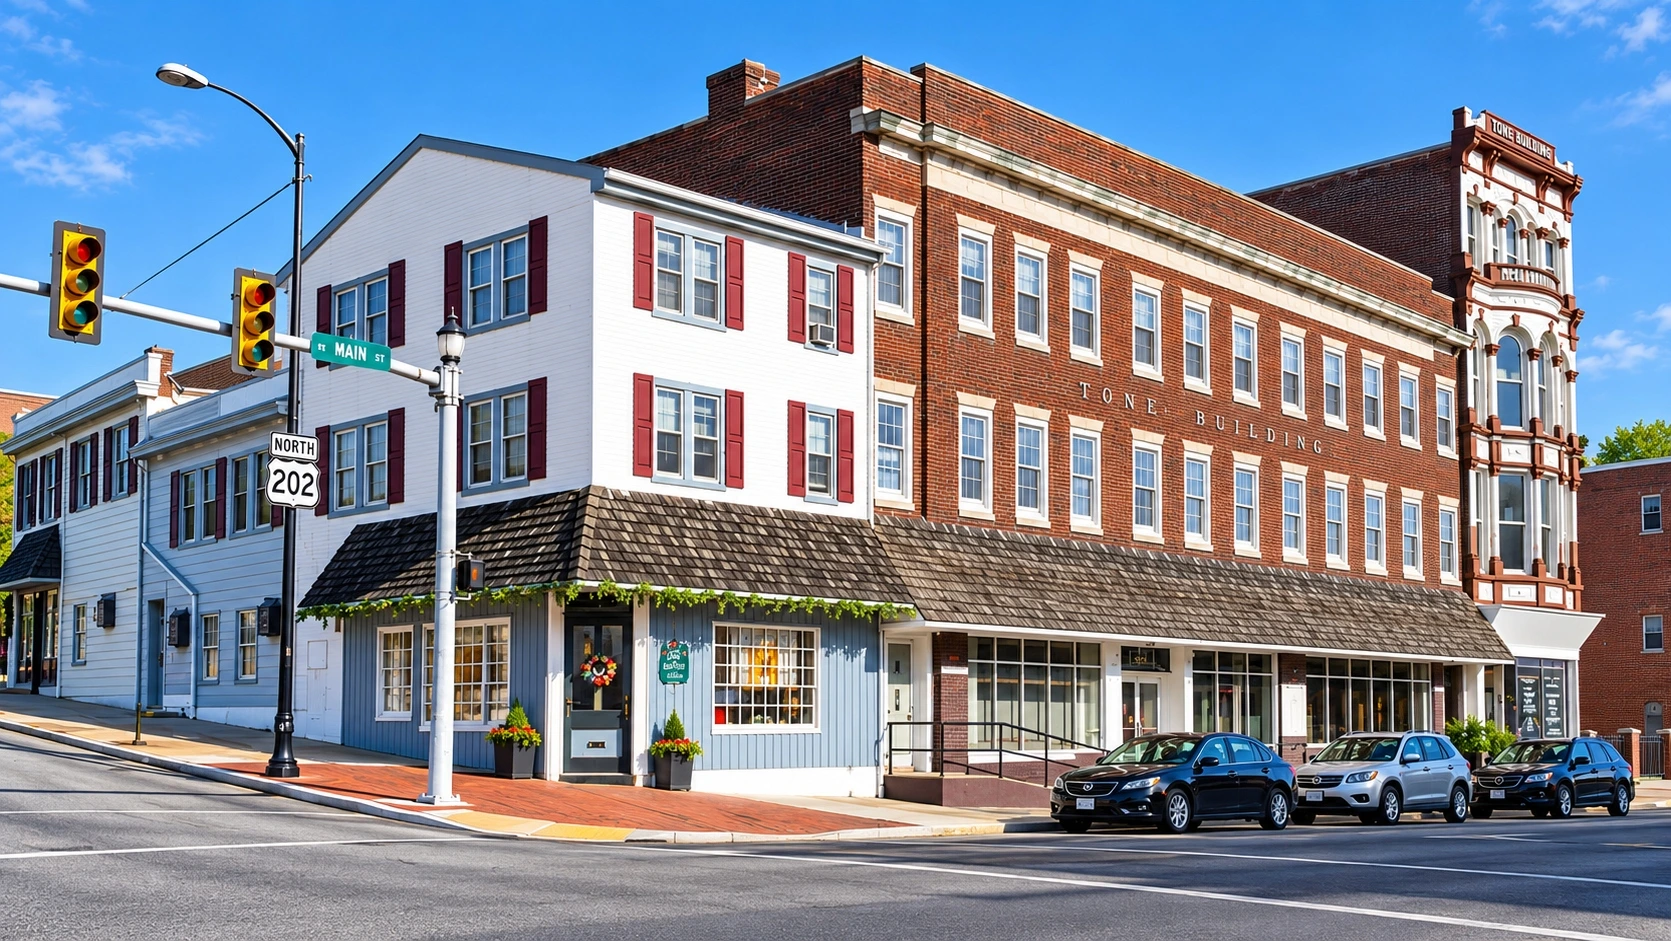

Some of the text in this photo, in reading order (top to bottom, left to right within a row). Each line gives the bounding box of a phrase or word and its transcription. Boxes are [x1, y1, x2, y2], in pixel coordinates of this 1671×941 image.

[334, 341, 367, 362] MAIN
[374, 353, 385, 363] ST
[1079, 381, 1322, 454] TONE BUILDING
[274, 437, 314, 456] NORTH
[271, 468, 314, 497] 202
